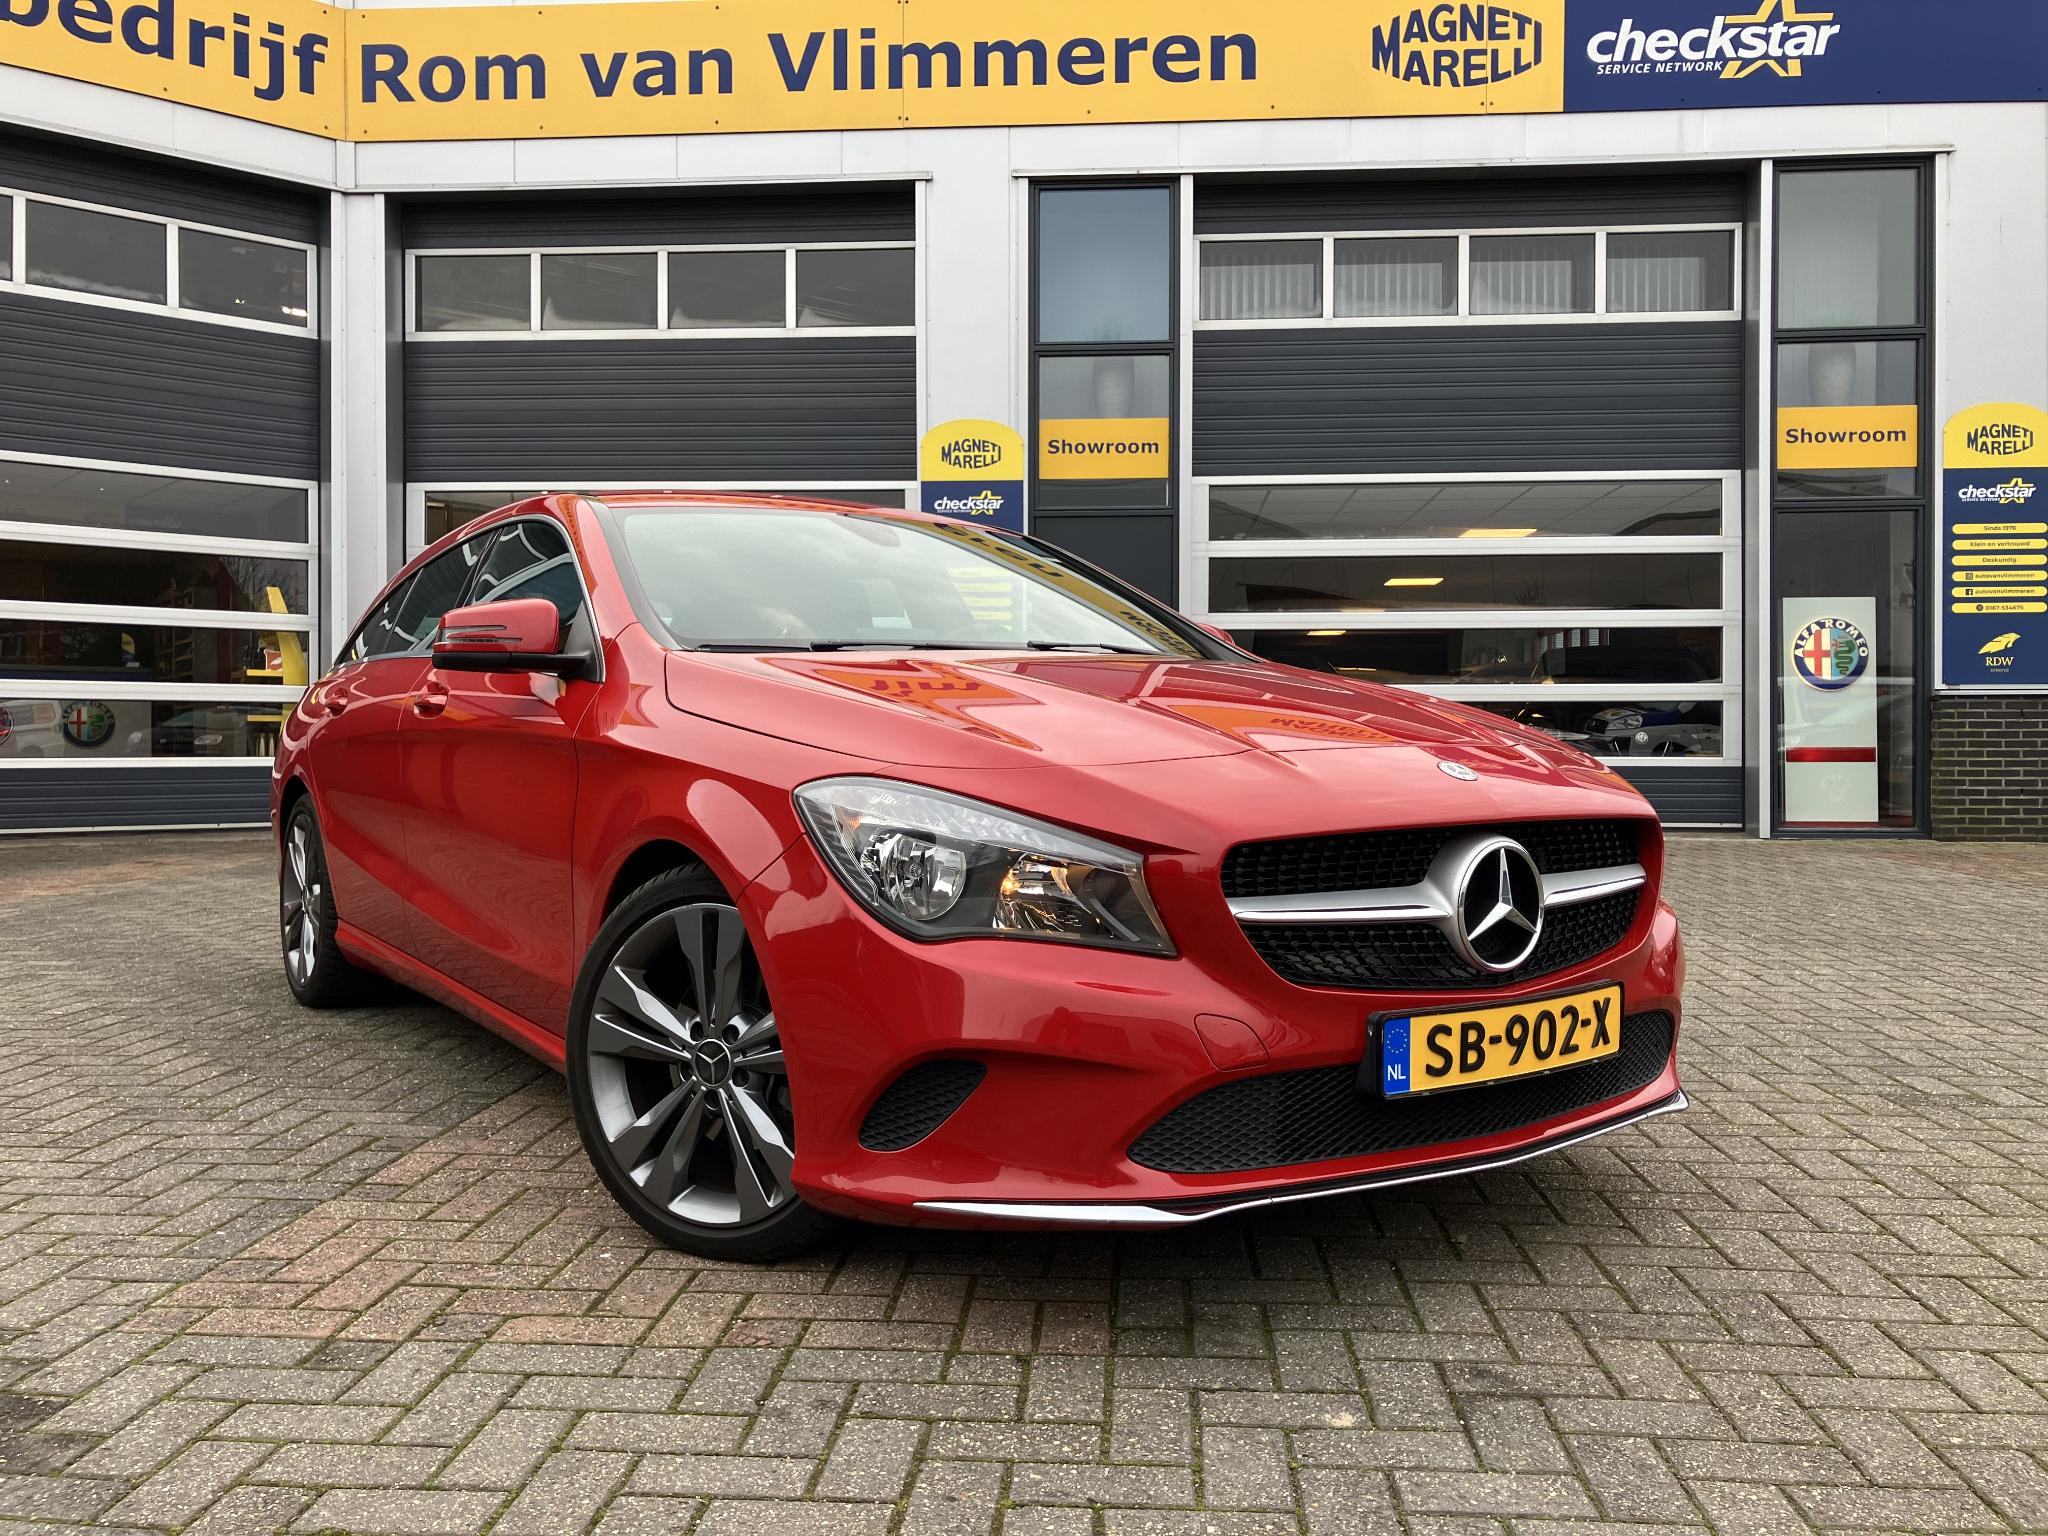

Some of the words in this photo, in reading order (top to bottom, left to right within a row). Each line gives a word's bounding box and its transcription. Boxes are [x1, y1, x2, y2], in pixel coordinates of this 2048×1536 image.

[1587, 16, 1840, 64] checkstar
[361, 44, 547, 104] Rom
[580, 47, 733, 98] van
[767, 27, 1258, 93] Vlimmeren
[1597, 62, 1652, 75] SERVICE
[1655, 60, 1724, 74] NETWORK
[1785, 428, 1907, 444] Showroom
[1047, 439, 1160, 454] Showroom
[1958, 484, 2037, 498] checkstar
[933, 496, 1005, 510] checkstar
[1794, 623, 1821, 657] ALFA
[1821, 618, 1868, 658] ROMEO
[1985, 656, 2015, 666] RDW
[1425, 997, 1611, 1078] SB-902-X
[1387, 1064, 1406, 1081] NL
